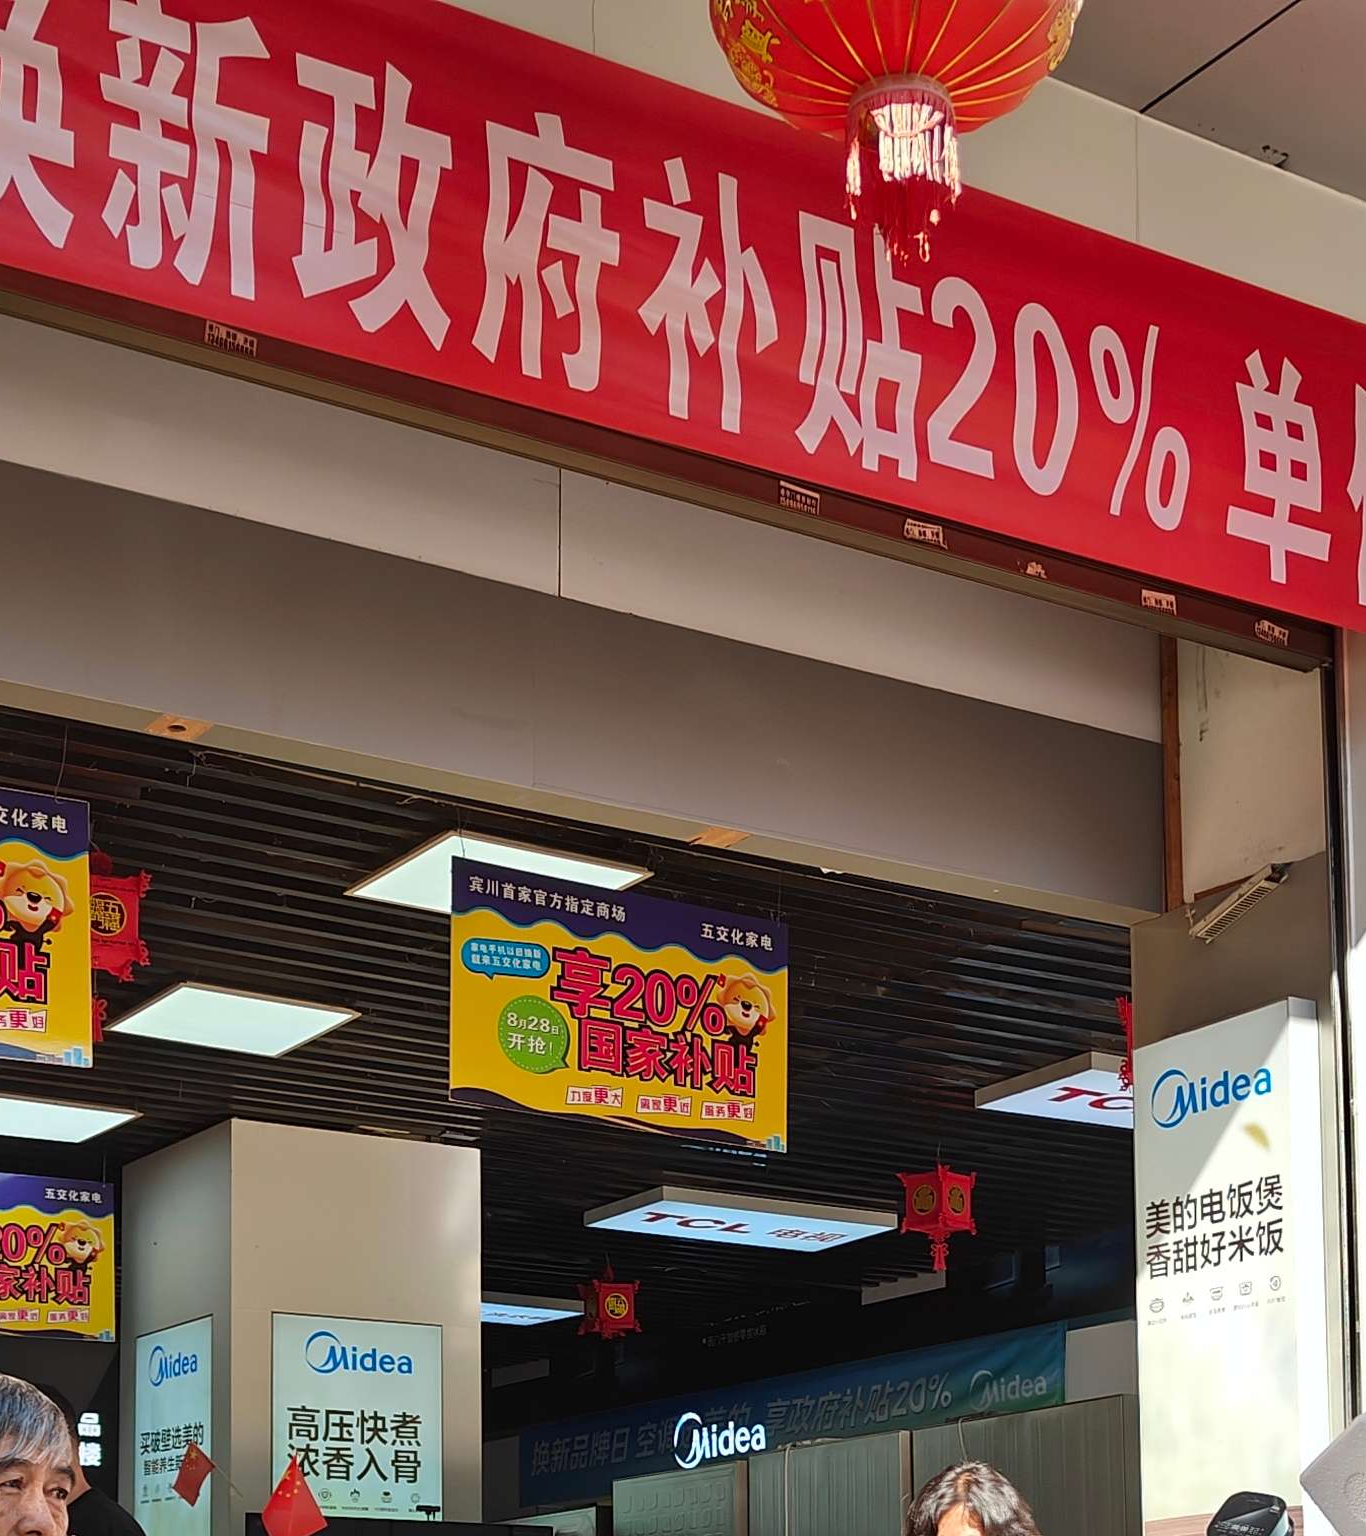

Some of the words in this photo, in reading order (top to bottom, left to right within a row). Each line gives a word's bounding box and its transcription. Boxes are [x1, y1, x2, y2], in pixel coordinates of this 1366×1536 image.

[468, 875, 626, 923] 宾川首家官方指定商场
[700, 922, 773, 951] 五交化家电
[550, 944, 727, 1039] 享20%
[506, 1011, 560, 1036] 8月28日
[577, 1016, 758, 1098] 国家补贴
[1151, 1067, 1272, 1129] Midea
[44, 1188, 103, 1204] 五交化家电
[642, 1211, 753, 1234] TCL
[1145, 1174, 1283, 1240] 美的电饭煲
[1145, 1218, 1284, 1280] 香甜好米饭
[149, 1345, 198, 1387] Midea
[305, 1331, 413, 1374] Midea
[286, 1406, 422, 1447] 高压快煮
[765, 1371, 952, 1436] 享政府补贴20%
[969, 1369, 1048, 1413] Midea
[286, 1444, 422, 1484] 浓香入骨
[672, 1411, 767, 1469] Midea
